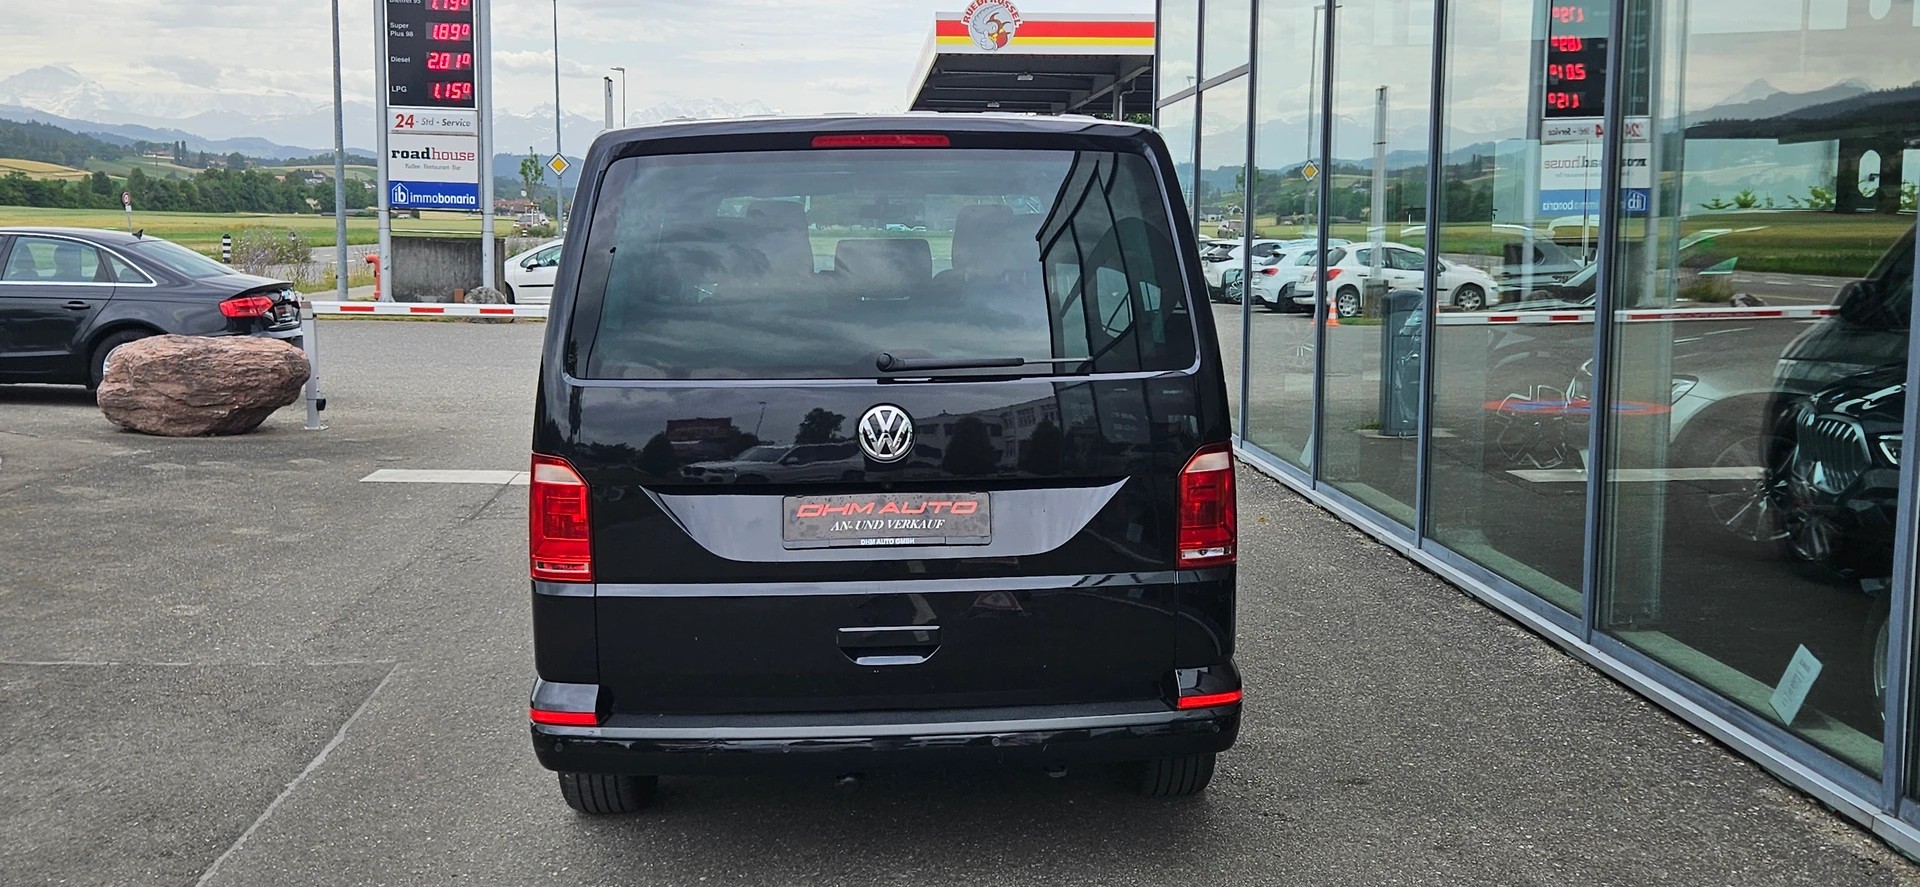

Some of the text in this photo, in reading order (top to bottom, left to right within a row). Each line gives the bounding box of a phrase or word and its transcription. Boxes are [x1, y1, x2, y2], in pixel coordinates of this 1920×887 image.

[395, 114, 471, 129] 24 Std Service
[391, 147, 475, 161] roadhouse
[394, 185, 476, 204] ib immobonaria
[796, 501, 978, 518] DHM AUTO
[855, 520, 884, 531] UND
[887, 519, 946, 530] VERKAUF
